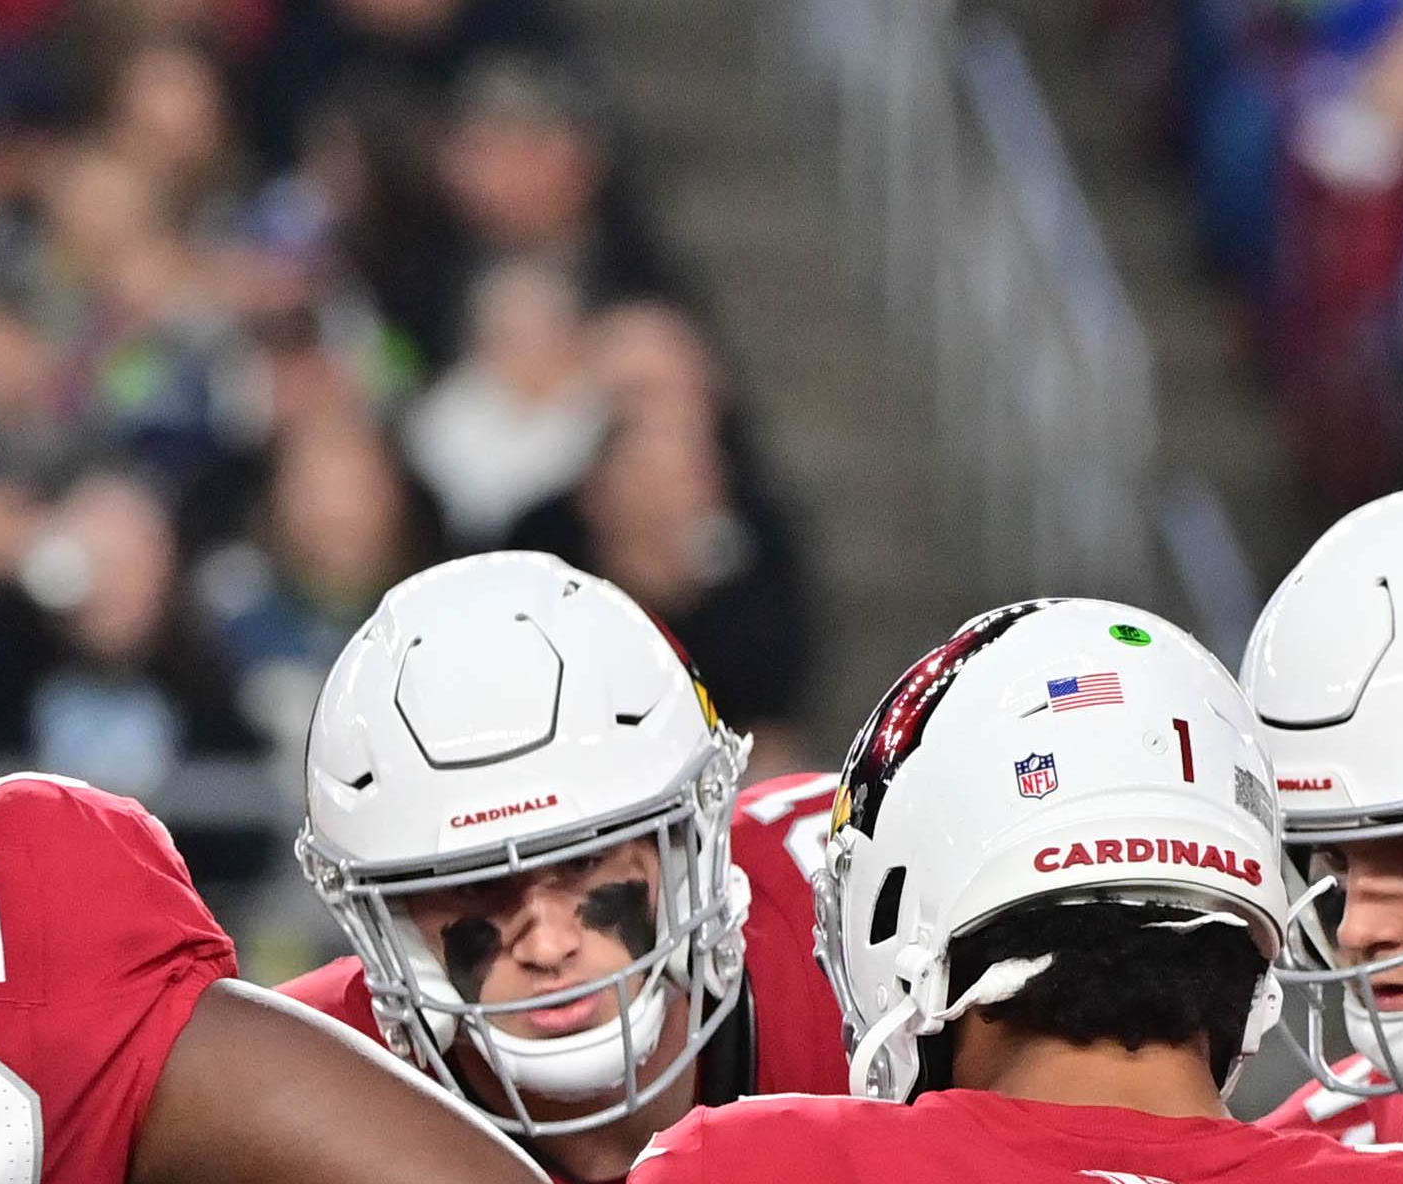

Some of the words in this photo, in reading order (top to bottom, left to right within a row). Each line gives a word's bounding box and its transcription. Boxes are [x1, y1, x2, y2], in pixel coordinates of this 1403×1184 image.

[1172, 719, 1195, 783] 1
[1020, 771, 1056, 795] NFL
[450, 794, 558, 828] CARDINALS
[1034, 838, 1263, 886] CARDINALS
